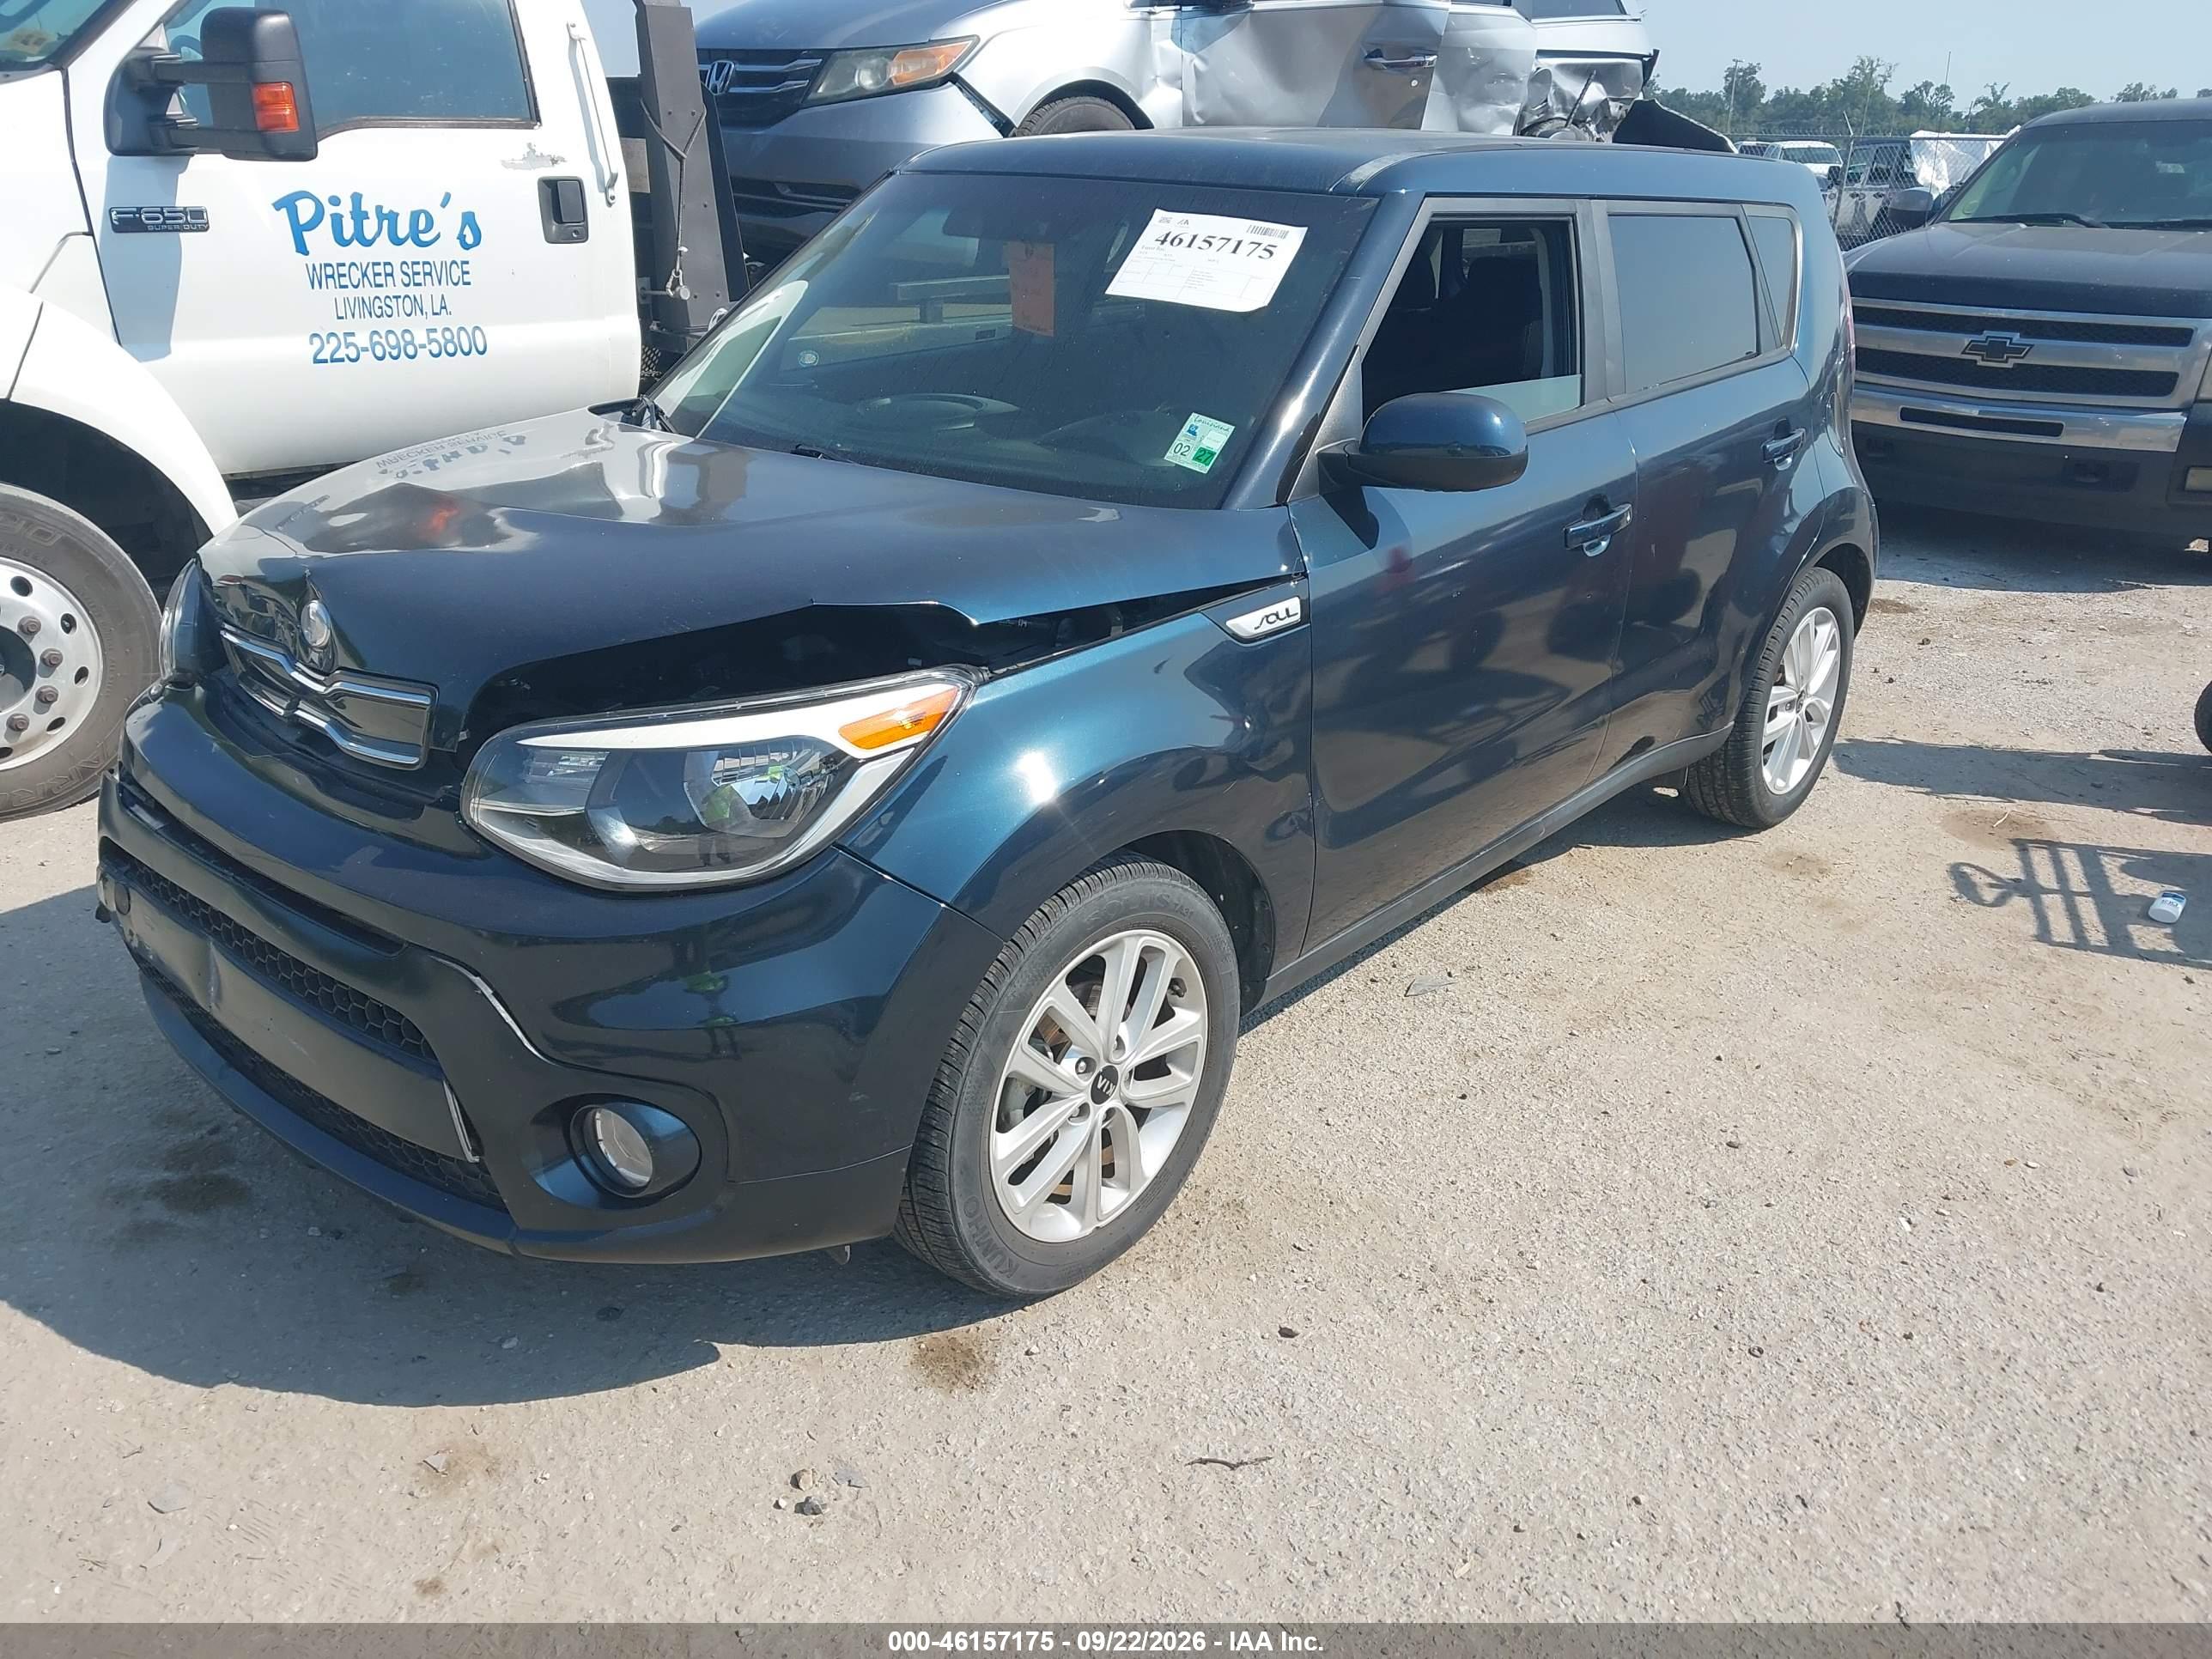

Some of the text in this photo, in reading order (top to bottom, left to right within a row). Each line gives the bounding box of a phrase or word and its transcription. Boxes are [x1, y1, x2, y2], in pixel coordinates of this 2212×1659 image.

[271, 190, 482, 256] Pitre's
[1154, 230, 1278, 260] 46157175
[305, 259, 471, 290] WRECKER SERVICE
[334, 294, 453, 320] LIVINGSTON, LA.
[308, 325, 488, 365] 225-698-5800
[1173, 442, 1214, 464] 02 27
[963, 1194, 1021, 1279] KUMHO
